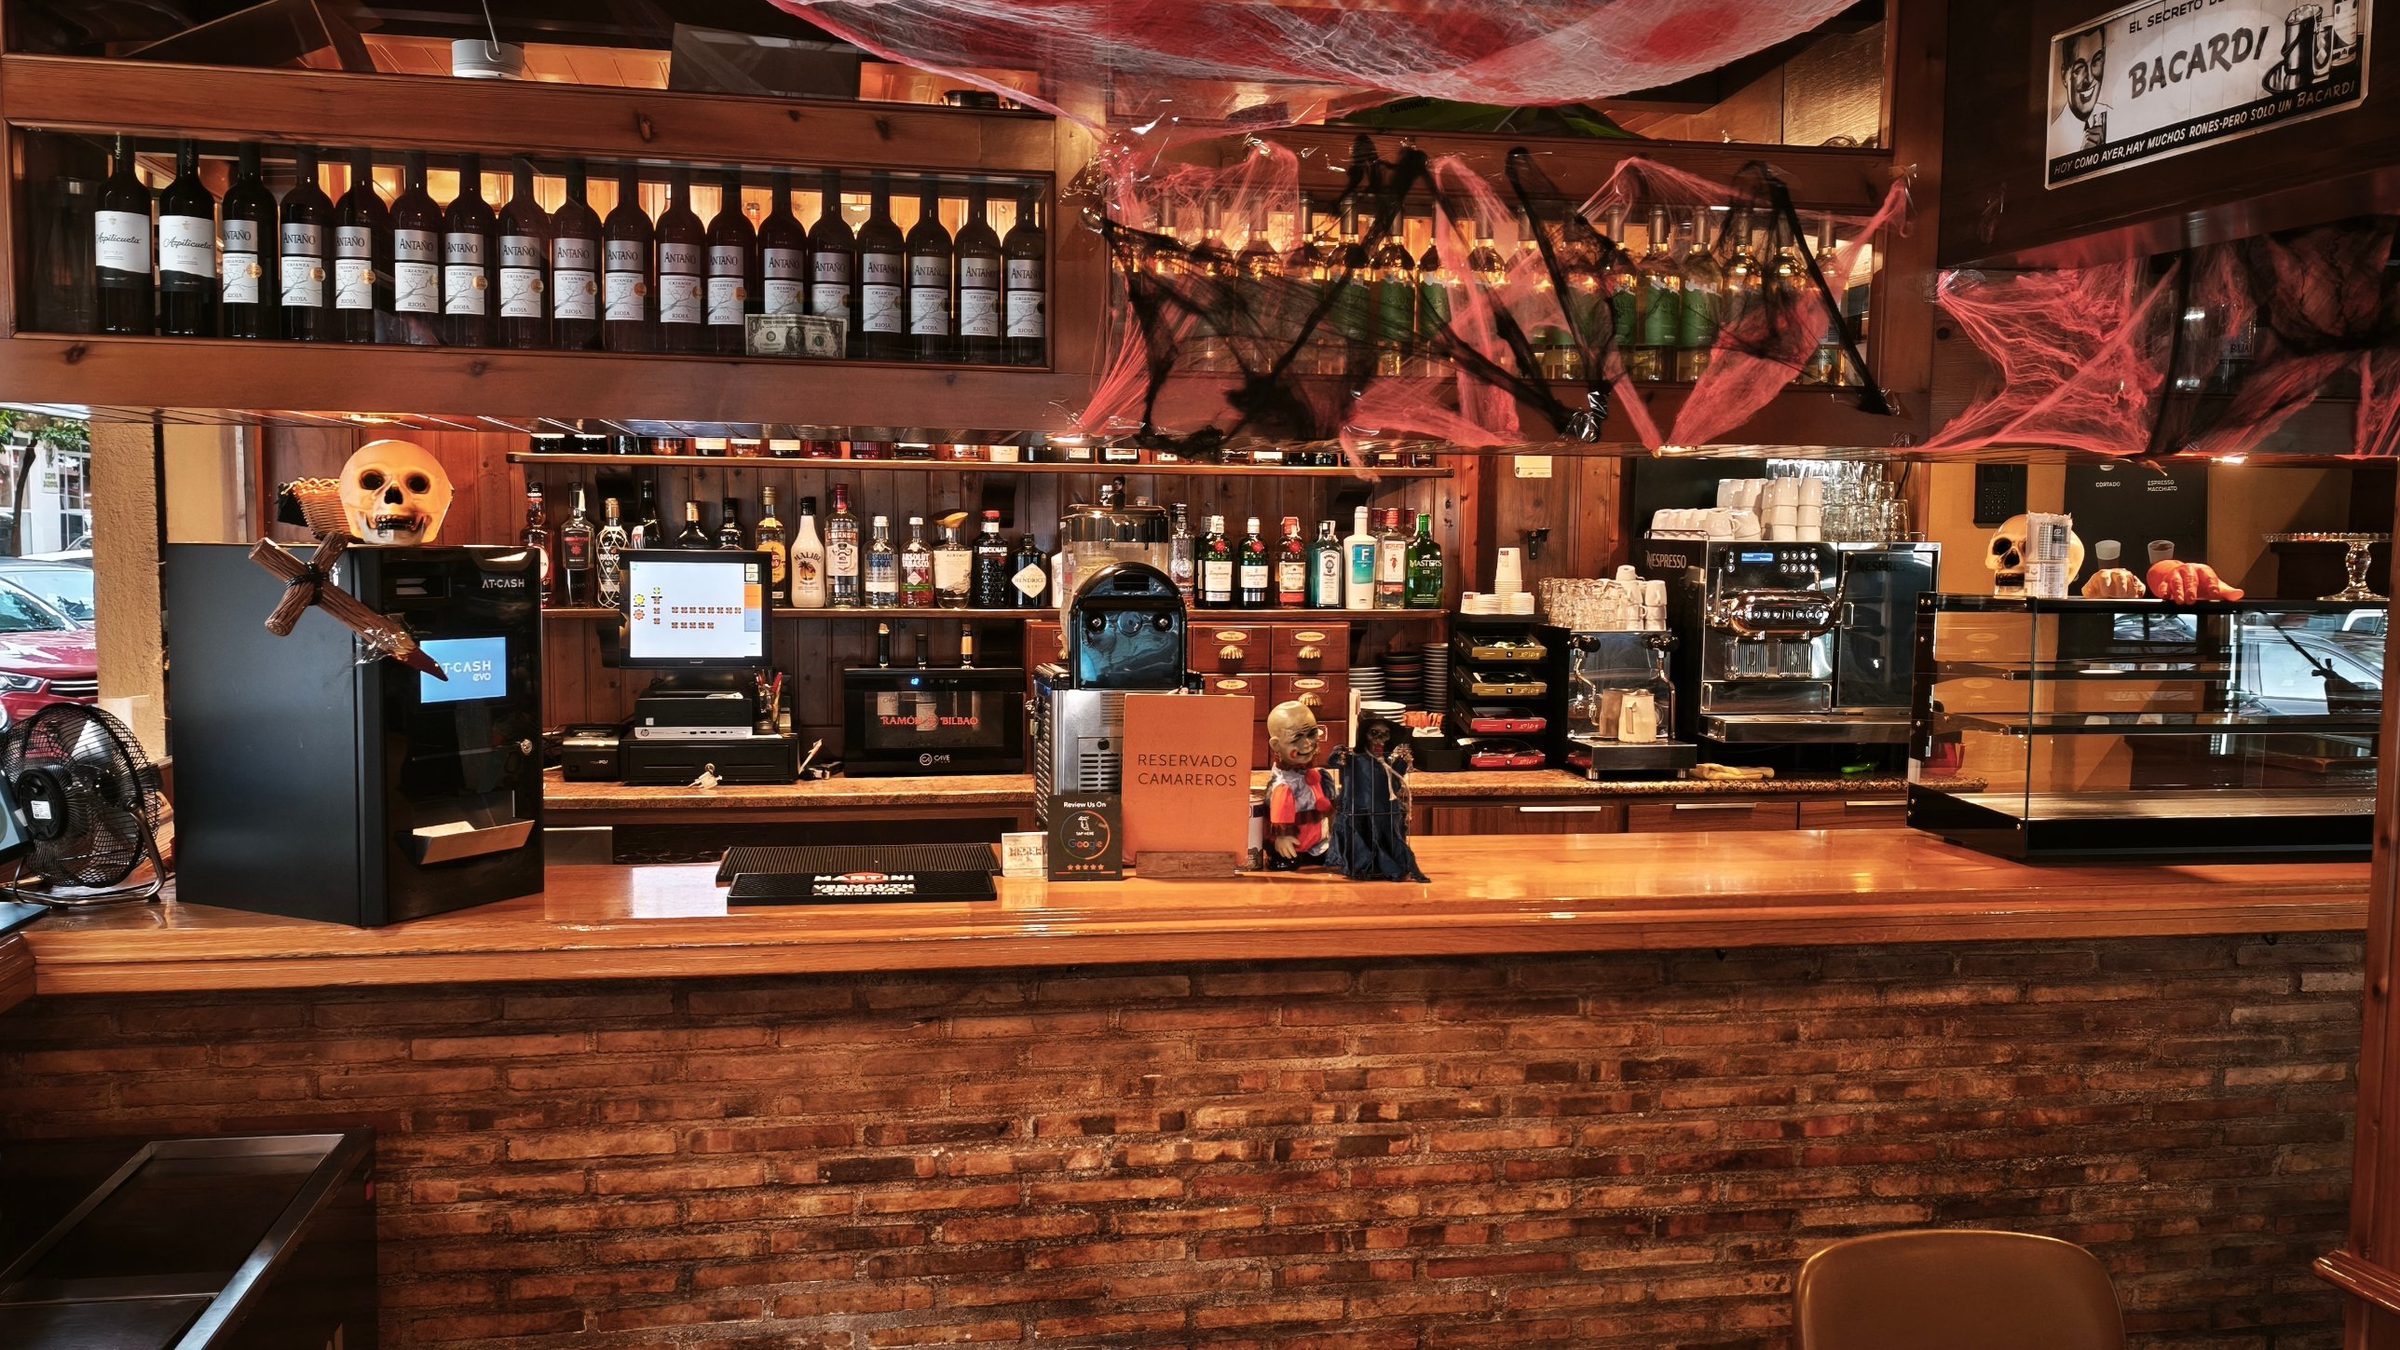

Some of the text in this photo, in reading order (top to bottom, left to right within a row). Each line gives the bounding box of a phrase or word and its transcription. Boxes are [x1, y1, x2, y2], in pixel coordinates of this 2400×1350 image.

[2129, 22, 2142, 34] EL
[2147, 0, 2203, 27] SECRETO
[2128, 26, 2269, 99] BACARDI
[2054, 160, 2073, 175] HOY
[2074, 153, 2099, 169] COMO
[2147, 128, 2186, 149] MUCHOS
[2250, 103, 2275, 121] SOLO
[2277, 99, 2292, 113] UN
[2297, 80, 2355, 107] BACARDI
[283, 231, 316, 245] ANTAÑO
[400, 238, 433, 251] ANTAÑO
[447, 241, 478, 254] ANTAÑO
[503, 244, 536, 256] ANTAÑO
[557, 247, 589, 259] ANTAÑO
[608, 248, 638, 261] ANTAÑO
[664, 251, 696, 264] ANTAÑO
[1361, 548, 1370, 560] F
[1646, 550, 1687, 570] NESPRESSO
[1409, 559, 1442, 568] MASTER'S
[473, 672, 491, 681] evo
[940, 716, 979, 725] BILBAO
[1138, 753, 1237, 768] RESERVADO
[1138, 773, 1237, 786] CAMAREROS
[814, 874, 914, 882] MARTINI
